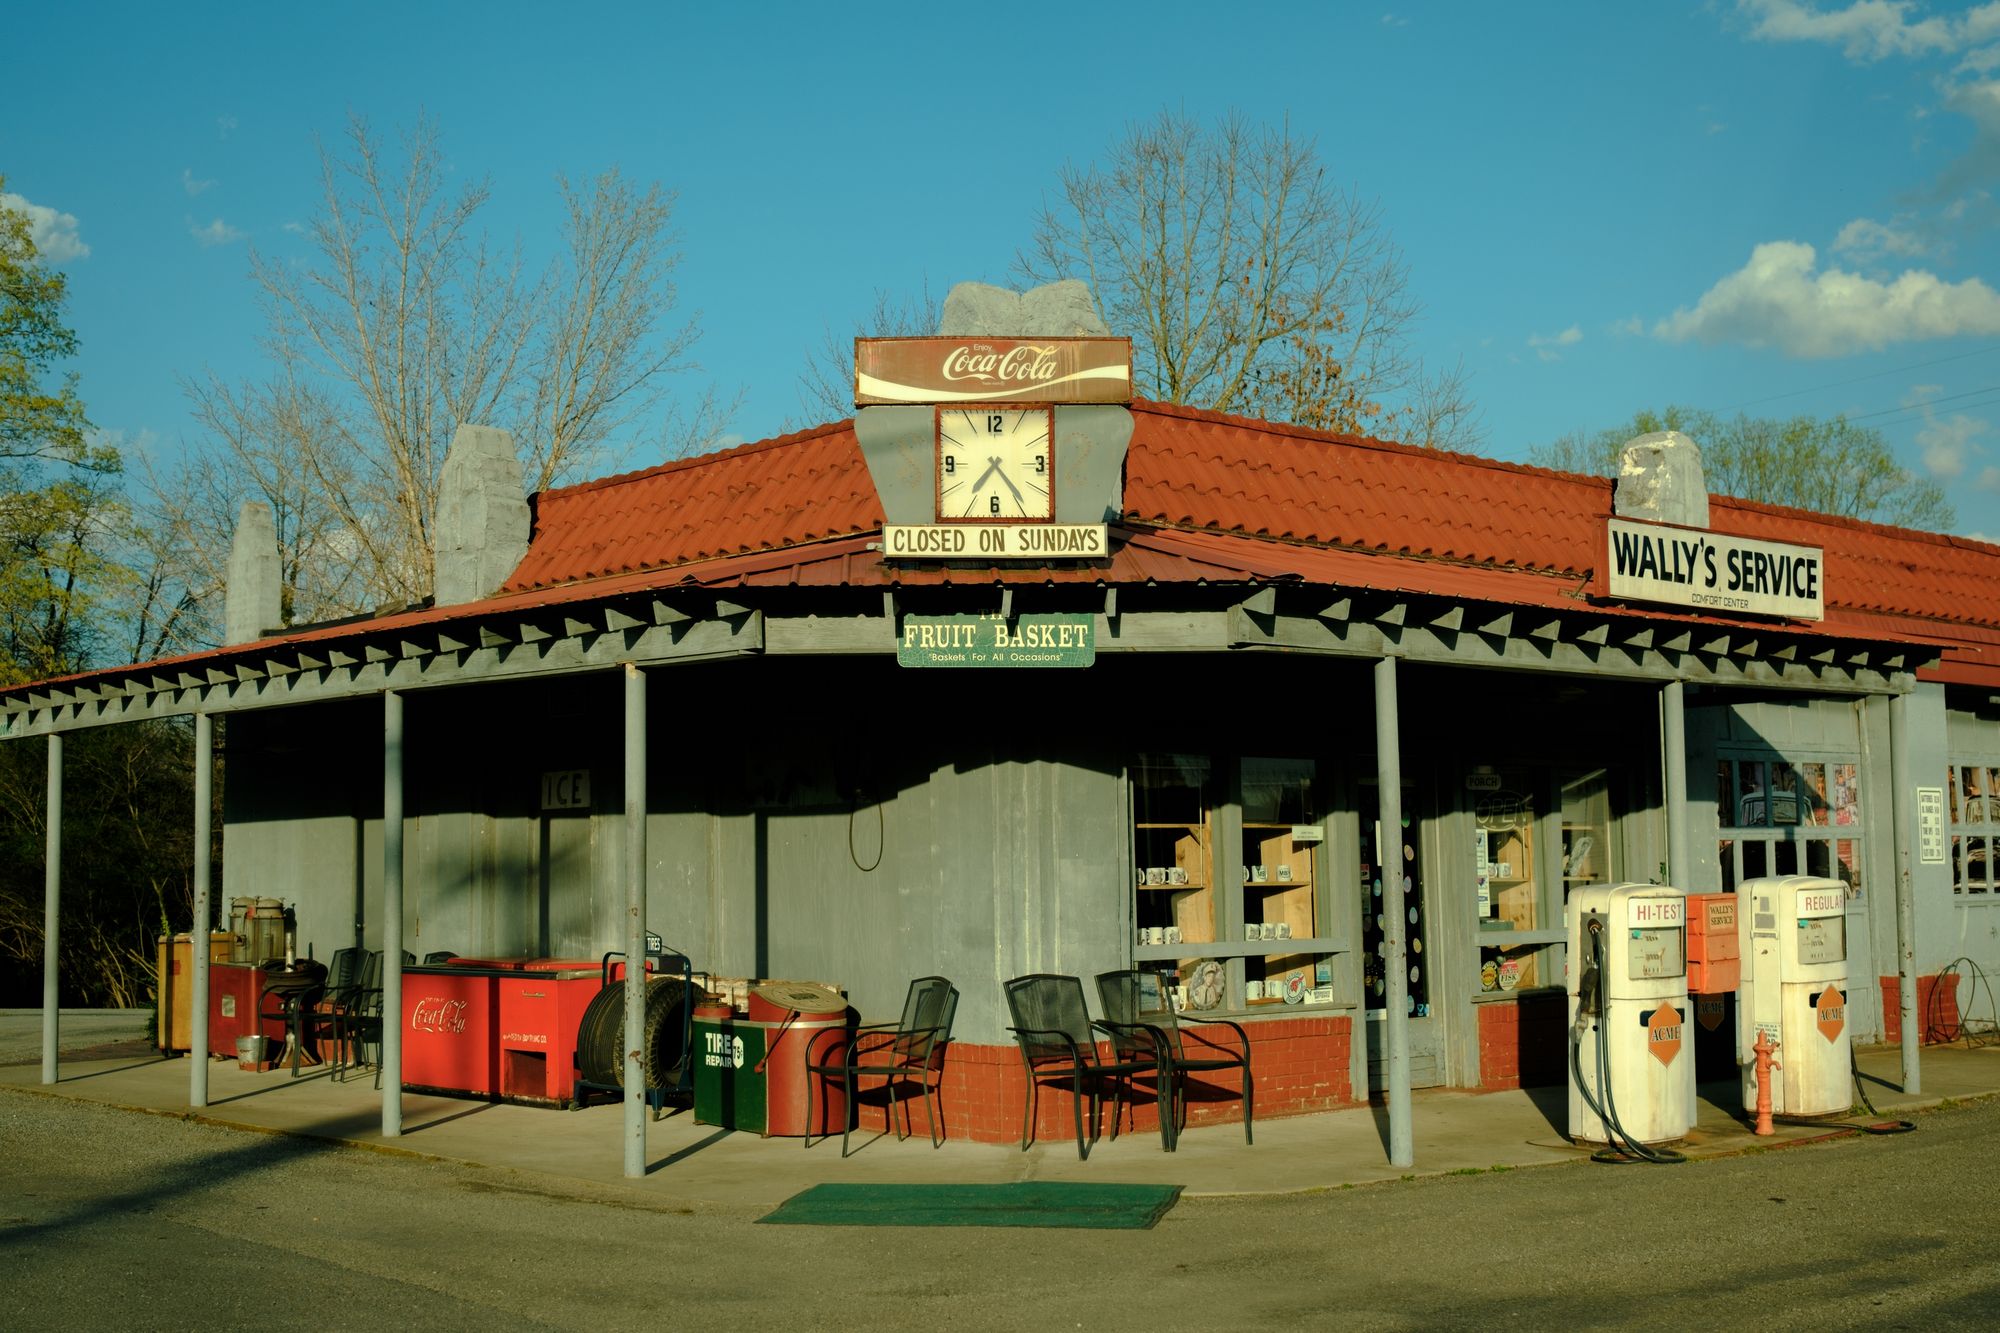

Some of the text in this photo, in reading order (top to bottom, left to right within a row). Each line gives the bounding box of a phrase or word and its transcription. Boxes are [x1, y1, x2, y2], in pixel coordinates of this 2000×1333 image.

[973, 344, 993, 352] Enjoy
[942, 345, 1061, 380] Coca-Cola
[987, 415, 1003, 432] 12
[945, 455, 955, 472] 9
[1035, 455, 1045, 472] 3
[990, 496, 1000, 513] 6
[893, 528, 1099, 552] CLOSED ON SUNDAYS
[1612, 530, 1817, 600] WALLY'S SERVICE
[1691, 593, 1749, 608] COMFORT CENTER
[903, 624, 1088, 648] FRUIT BASKET
[972, 653, 986, 661] For
[992, 653, 1003, 661] All
[547, 773, 583, 806] ICE
[1476, 798, 1527, 823] OPEN
[1637, 904, 1682, 920] HI-TEST
[1710, 904, 1734, 914] WALLY'S
[1711, 915, 1733, 925] SERVICE
[1652, 1025, 1681, 1041] ACME
[705, 1032, 732, 1055] TIRE
[705, 1054, 732, 1068] REPAIR
